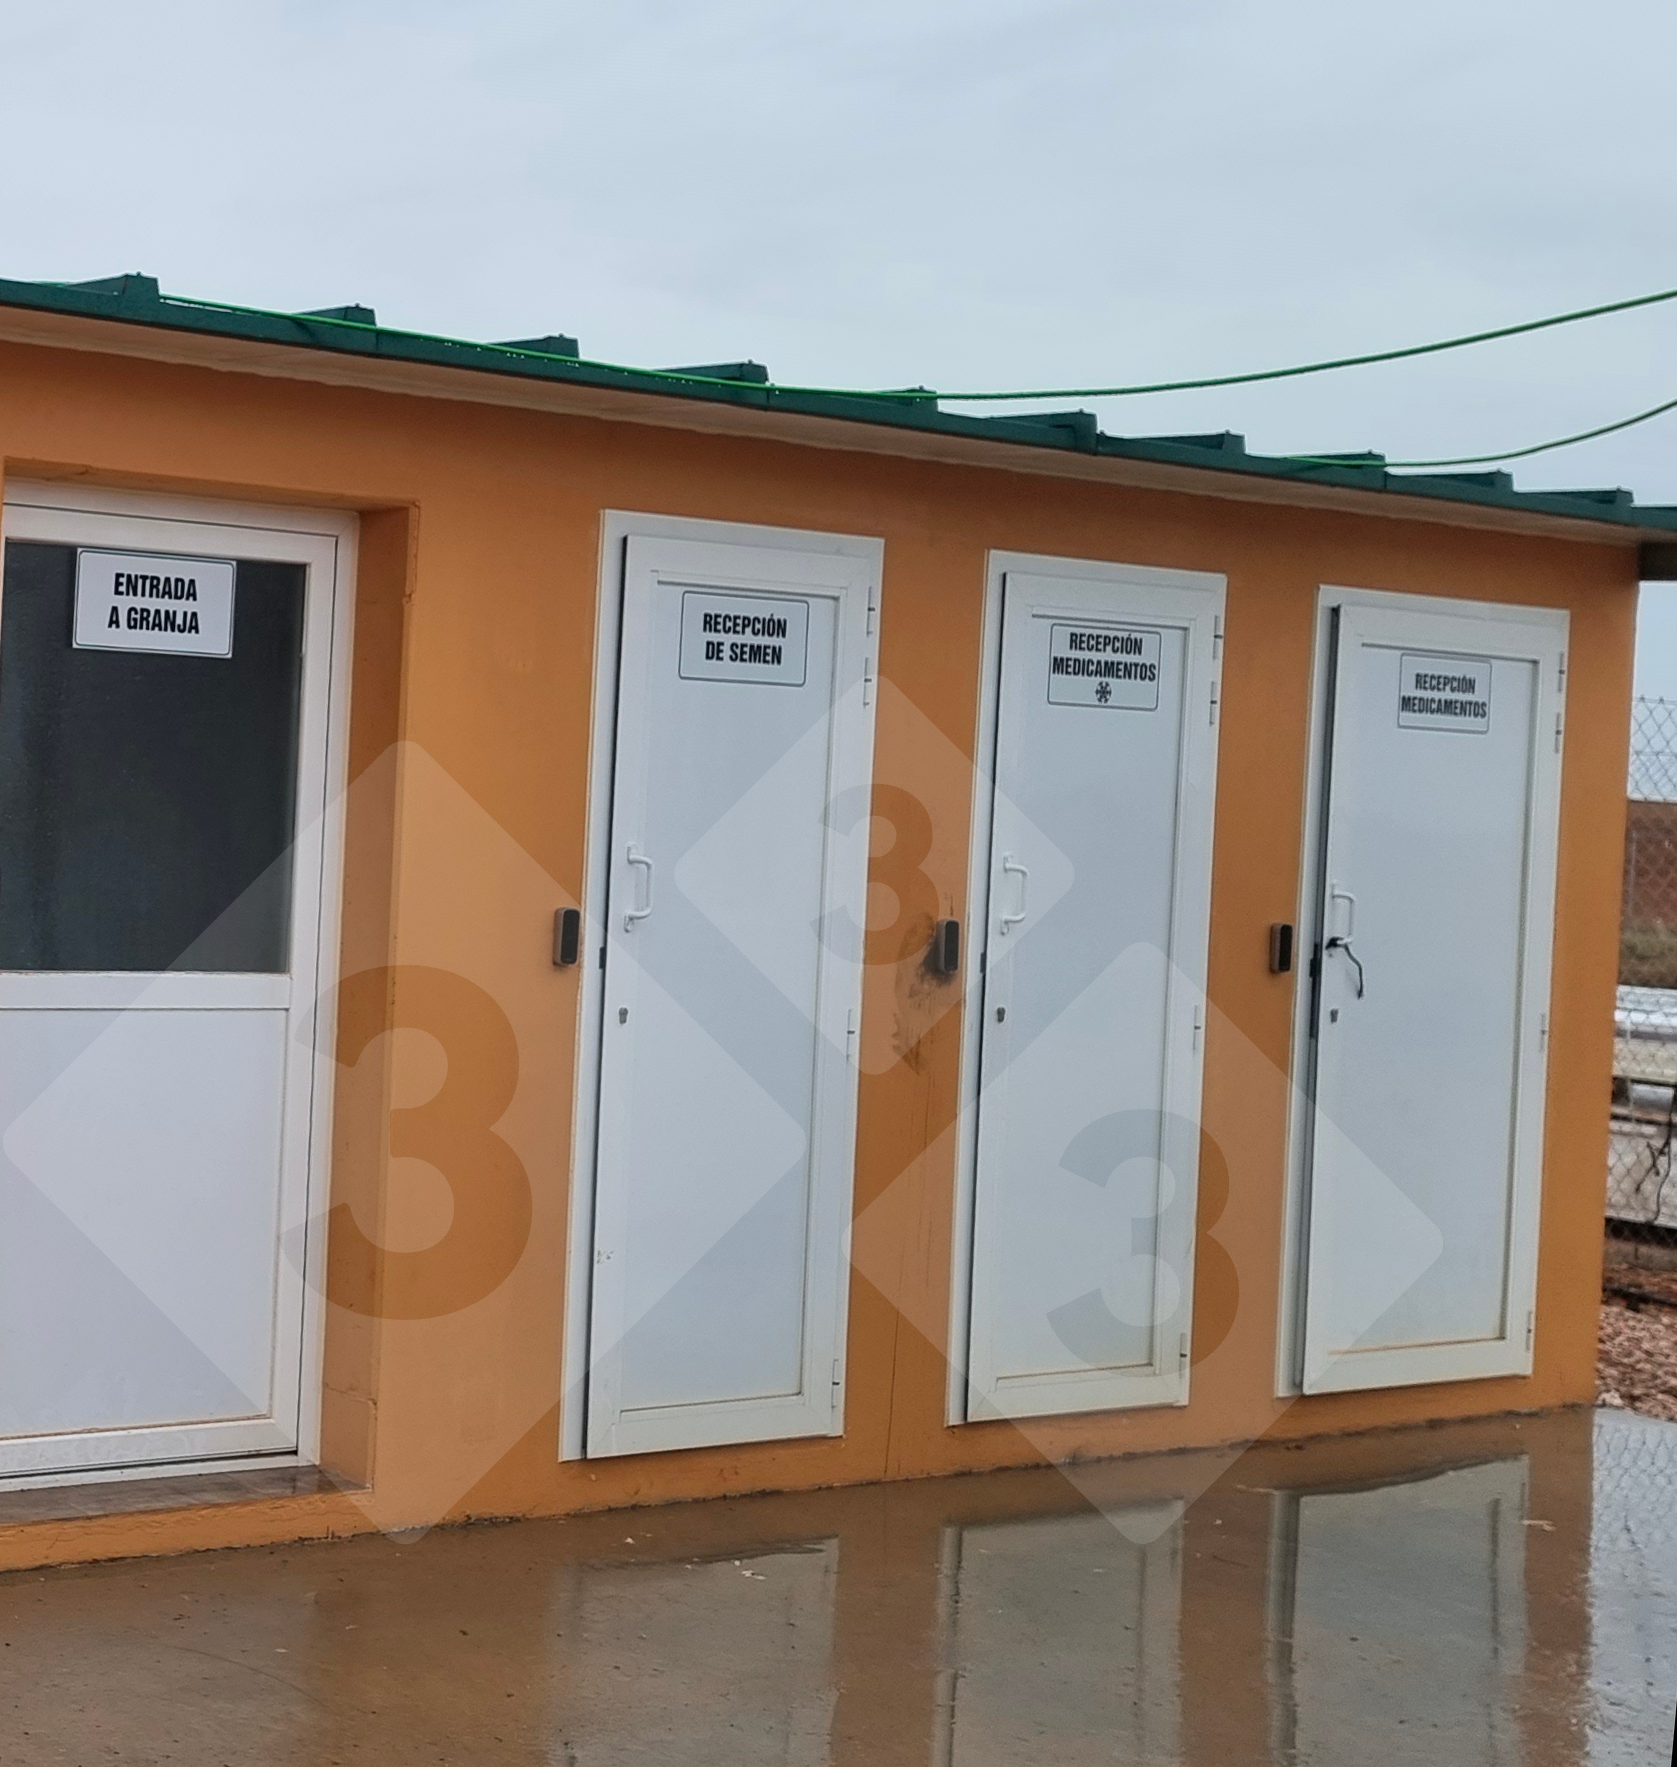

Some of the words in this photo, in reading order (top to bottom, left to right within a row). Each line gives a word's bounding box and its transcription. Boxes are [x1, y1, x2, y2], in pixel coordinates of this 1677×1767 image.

[113, 572, 198, 602] ENTRADA
[107, 605, 120, 629] A
[126, 606, 200, 635] GRANJA
[702, 612, 788, 639] RECEPCIÓN
[705, 640, 725, 662] DE
[729, 642, 783, 666] SEMEN
[1069, 632, 1143, 656] RECEPCIÓN
[1052, 655, 1157, 682] MEDICAMENTOS
[1415, 672, 1476, 695] RECEPCIÓN
[1401, 695, 1487, 720] MEDICAMENTOS
